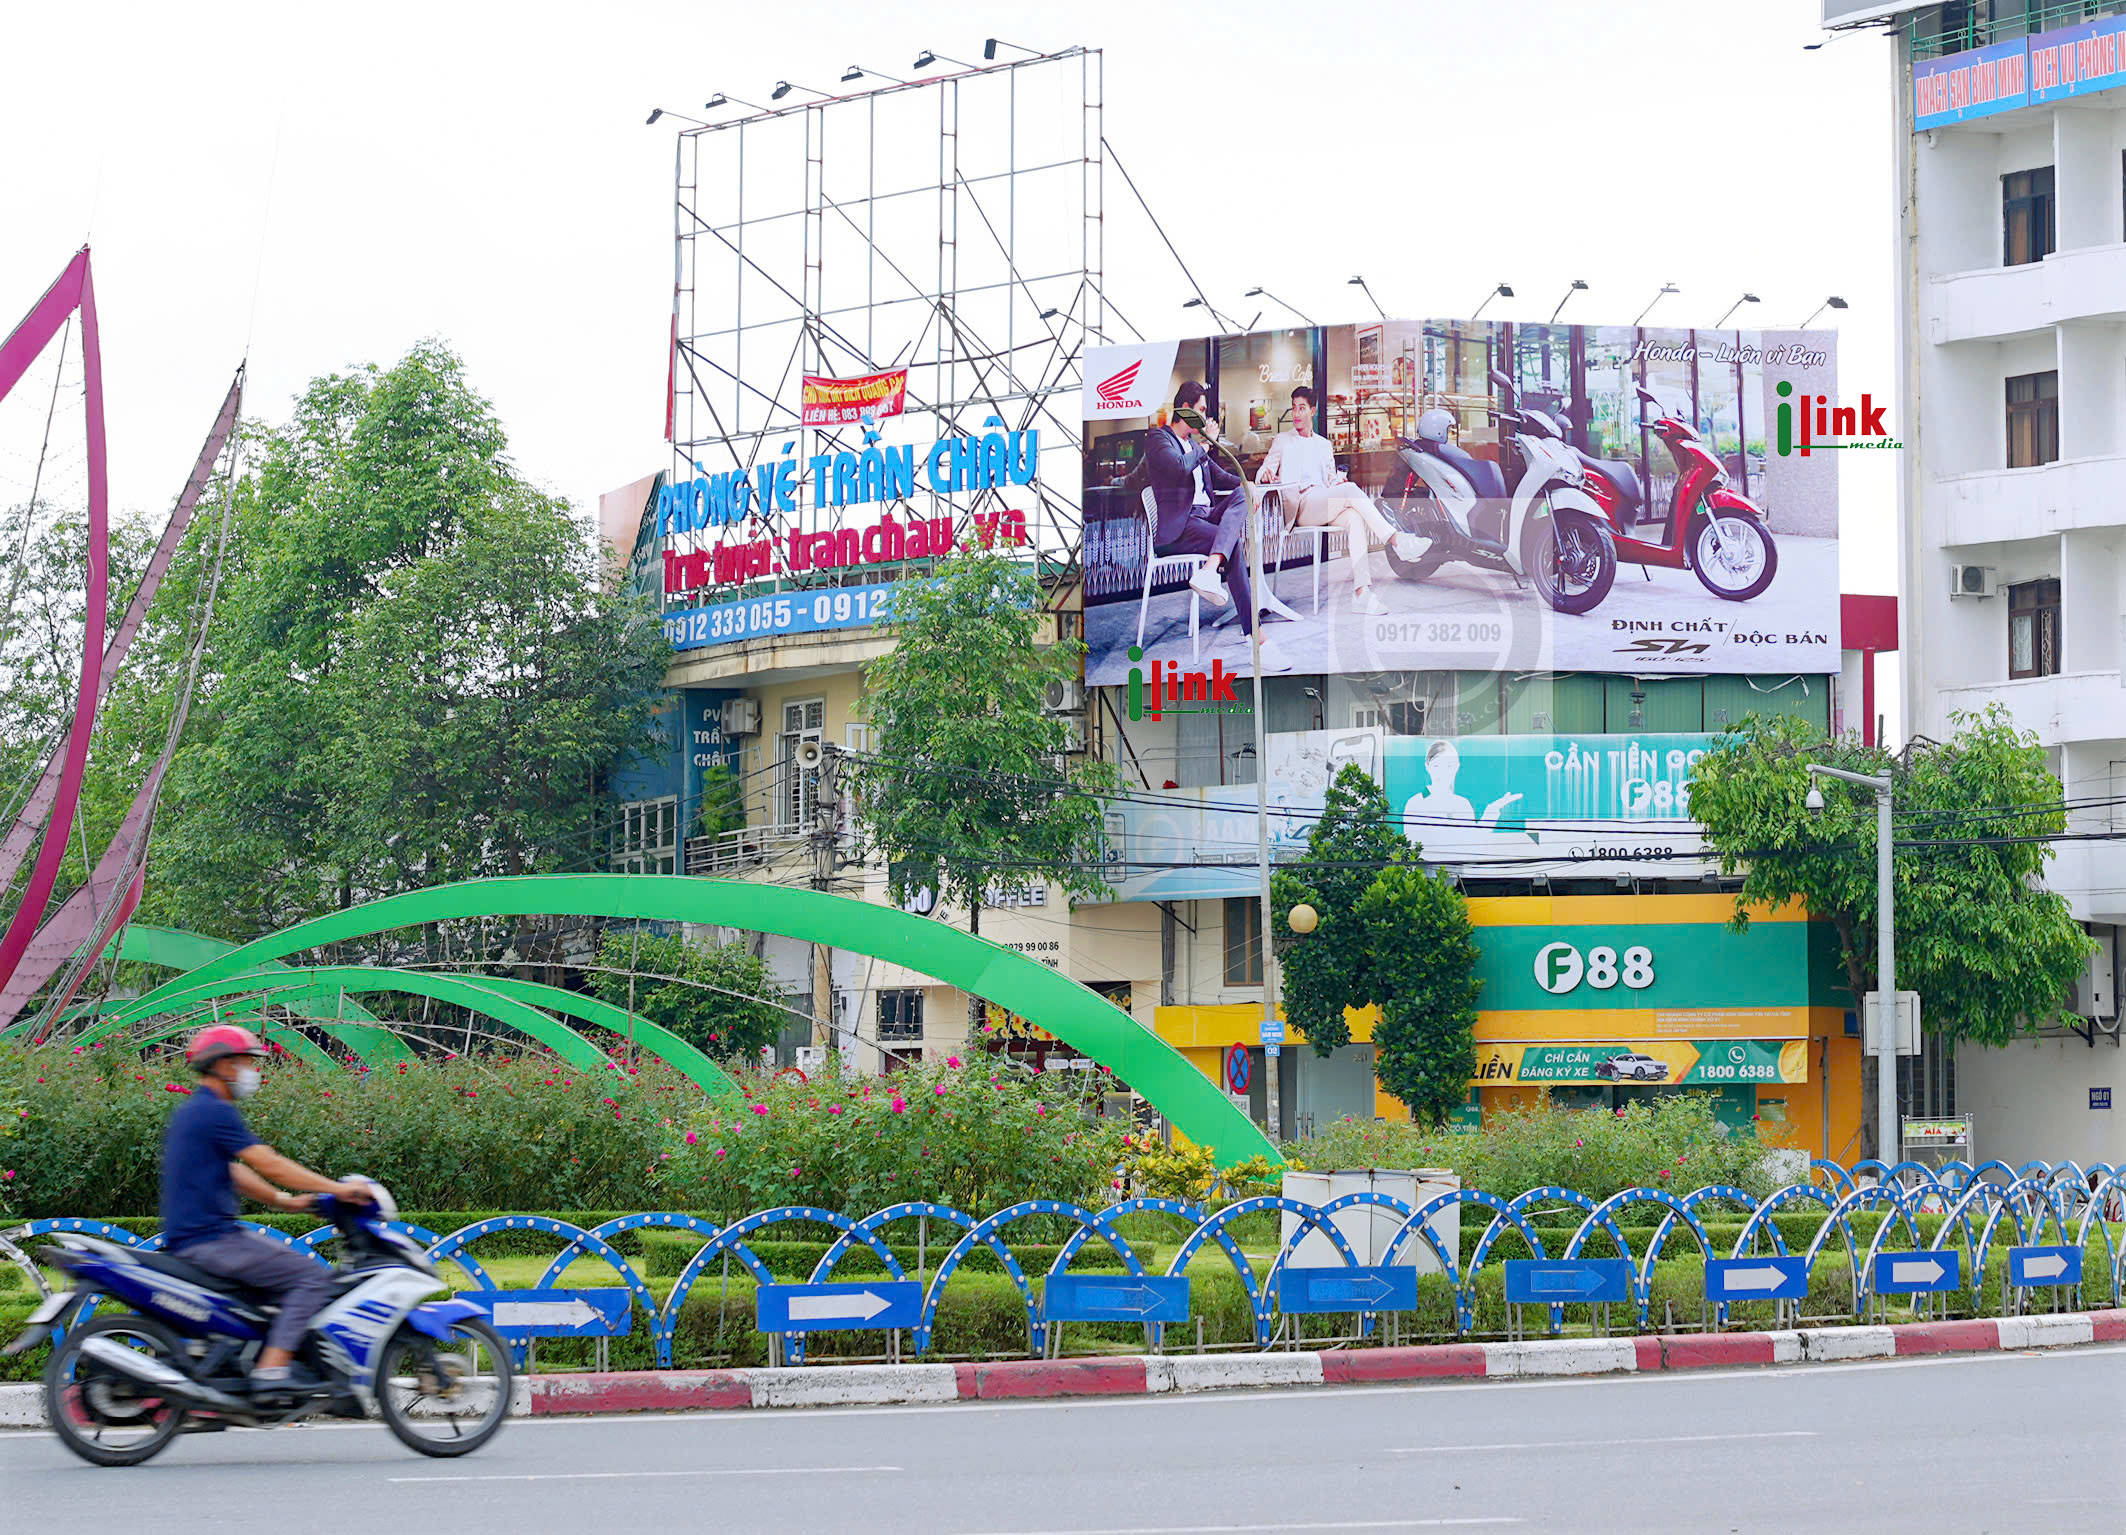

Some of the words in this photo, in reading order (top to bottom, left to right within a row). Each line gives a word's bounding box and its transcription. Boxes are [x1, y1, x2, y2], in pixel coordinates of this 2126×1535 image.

[2032, 46, 2059, 99] DỊCH
[2060, 42, 2076, 93] VỤ
[2077, 30, 2115, 81] PHÒNG
[1916, 68, 1949, 118] KHÁCH
[1950, 67, 1970, 118] SẠN
[1971, 57, 1996, 105] BÌNH
[1997, 54, 2025, 98] MINH
[1633, 340, 1695, 362] Honda
[1715, 342, 1762, 364] Luôn
[1766, 344, 1785, 364] vì
[1787, 344, 1826, 369] Bạn
[1096, 399, 1143, 409] HONDA
[805, 408, 826, 422] LIÊN
[657, 461, 751, 538] PHÒNG
[757, 441, 796, 517] VÉ
[809, 414, 914, 509] TRẦN
[928, 415, 1039, 493] CHÂU
[663, 612, 708, 645] 0912
[711, 606, 746, 638] 333
[751, 599, 792, 632] 055
[814, 589, 888, 624] 0912
[1612, 619, 1663, 633] ĐỊNH
[1671, 617, 1728, 633] CHẤT
[1733, 631, 1777, 647] ĐỘC
[1544, 742, 1600, 771] CẦN
[1607, 741, 1657, 770] TIỀN
[1620, 778, 1693, 811] F88
[1588, 847, 1628, 860] 1800
[1026, 942, 1036, 951] 99
[1038, 941, 1047, 951] 00
[1049, 941, 1059, 951] 86
[1534, 942, 1655, 994] F88
[1545, 1050, 1565, 1063] CHỈ
[1521, 1066, 1553, 1078] ĐĂNG
[1556, 1066, 1573, 1077] KÝ
[1573, 1067, 1589, 1077] XE
[1699, 1065, 1735, 1078] 1800
[1739, 1065, 1775, 1078] 6388
[1924, 1126, 1942, 1135] MÍA
